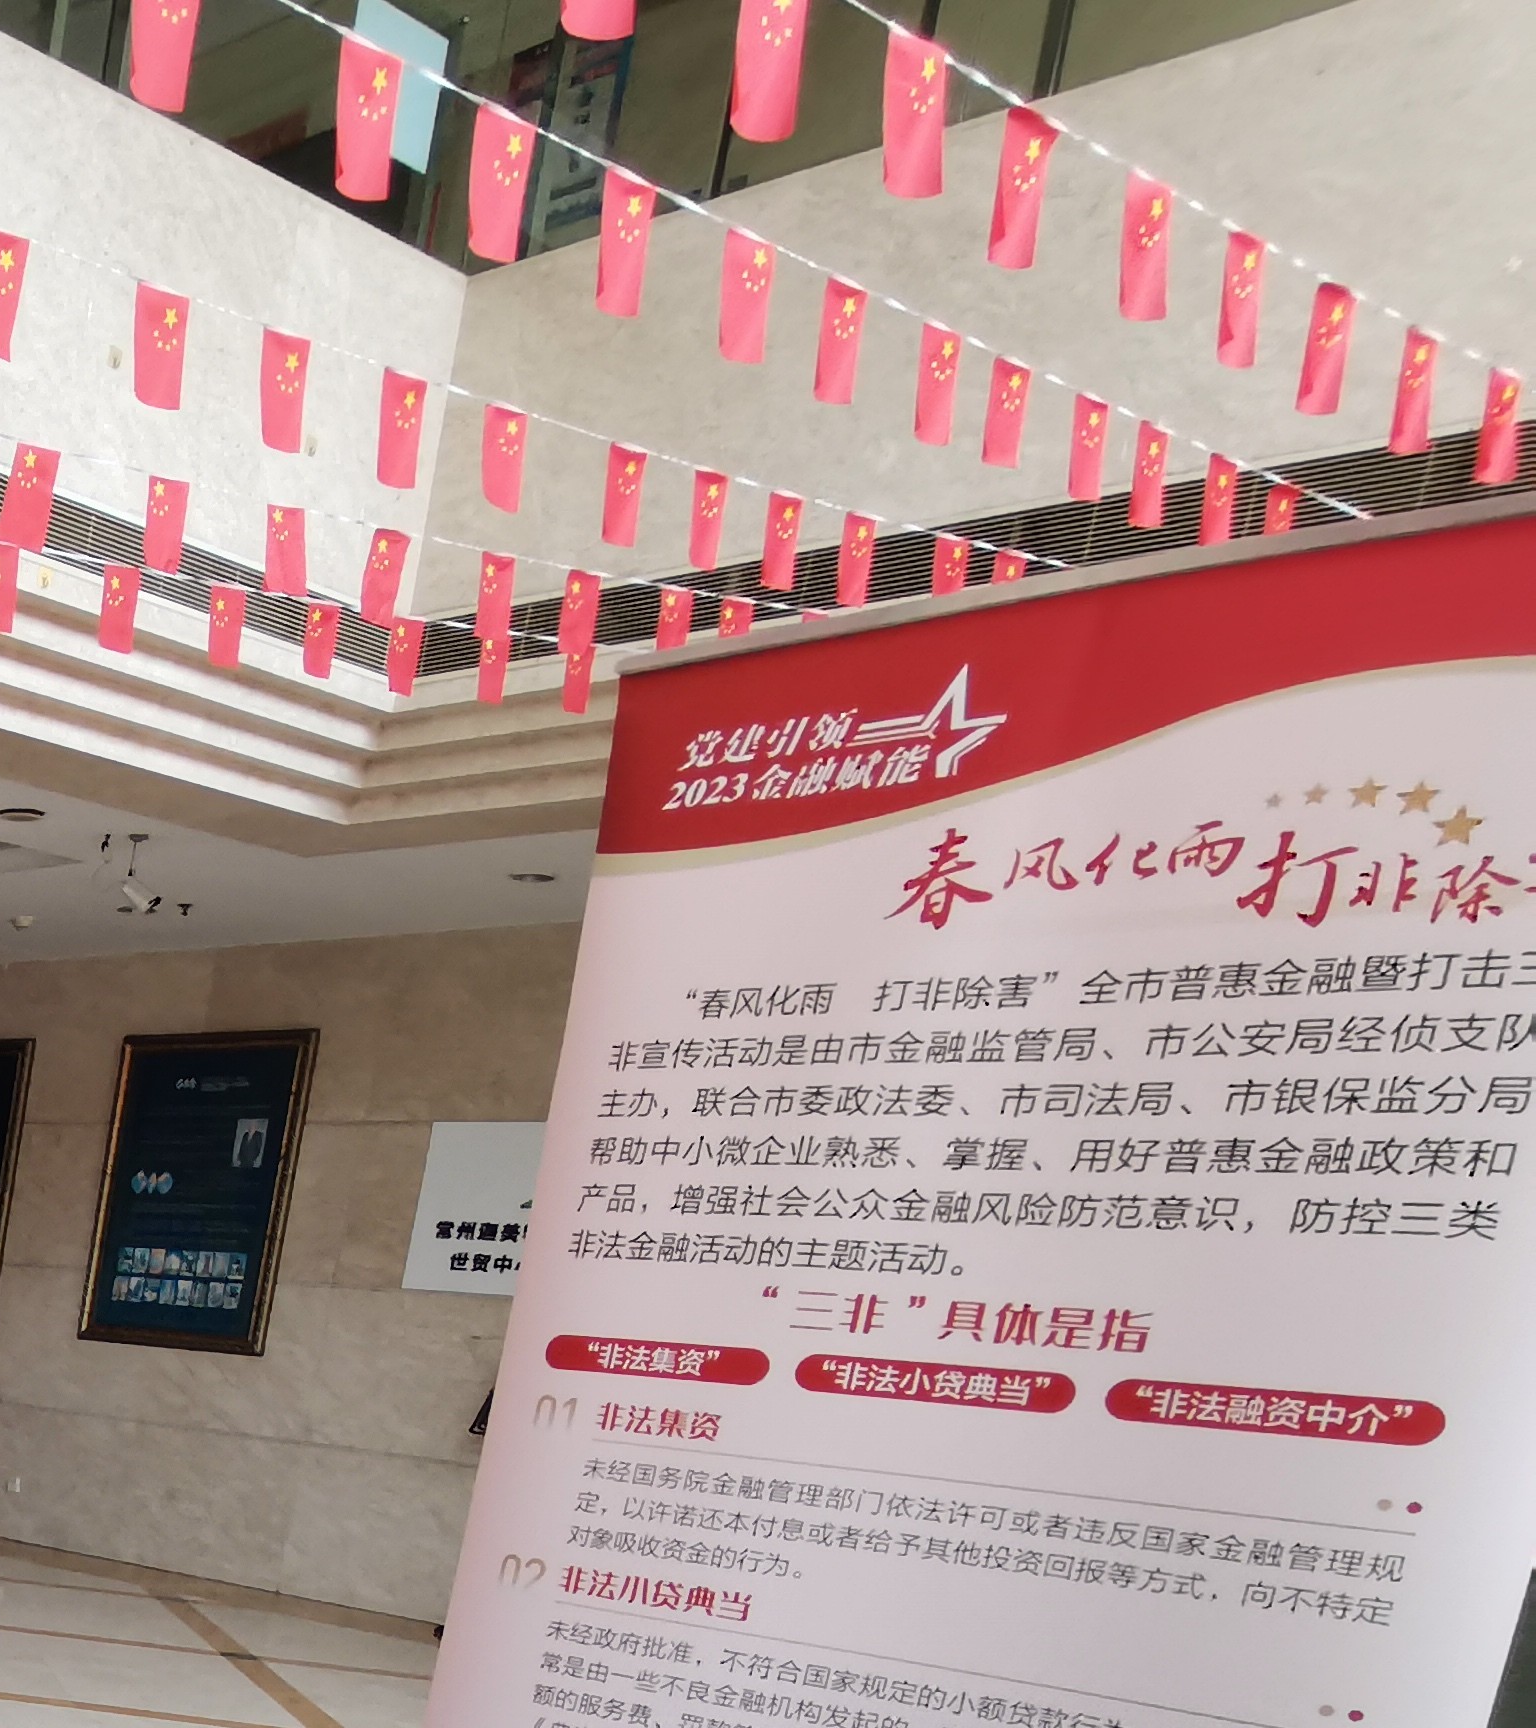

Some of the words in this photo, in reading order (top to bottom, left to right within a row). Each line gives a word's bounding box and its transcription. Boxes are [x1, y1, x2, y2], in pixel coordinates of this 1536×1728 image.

[679, 706, 859, 774] 党建引领
[662, 745, 931, 811] 2023金融赋能
[886, 819, 1536, 930] 春风化雨打非除
[589, 1136, 1517, 1177] 帮助中小微企业熟悉、掌握、用好普惠金融政策和
[450, 1252, 521, 1274] 世贸中
[567, 1229, 965, 1278] 非法金融活动的主题活动。
[588, 1342, 721, 1377] “非法集资”
[822, 1359, 1051, 1407] “非法小贷典当”
[597, 1401, 722, 1442] 非法集资
[1135, 1382, 1414, 1437] “非法融资中介”
[583, 1458, 1406, 1583] 未经国务院金融管理部门依法许可或者违反国家金融管理规
[566, 1525, 804, 1581] 对象吸收资金的行为。
[558, 1564, 753, 1623] 非法小贷典当
